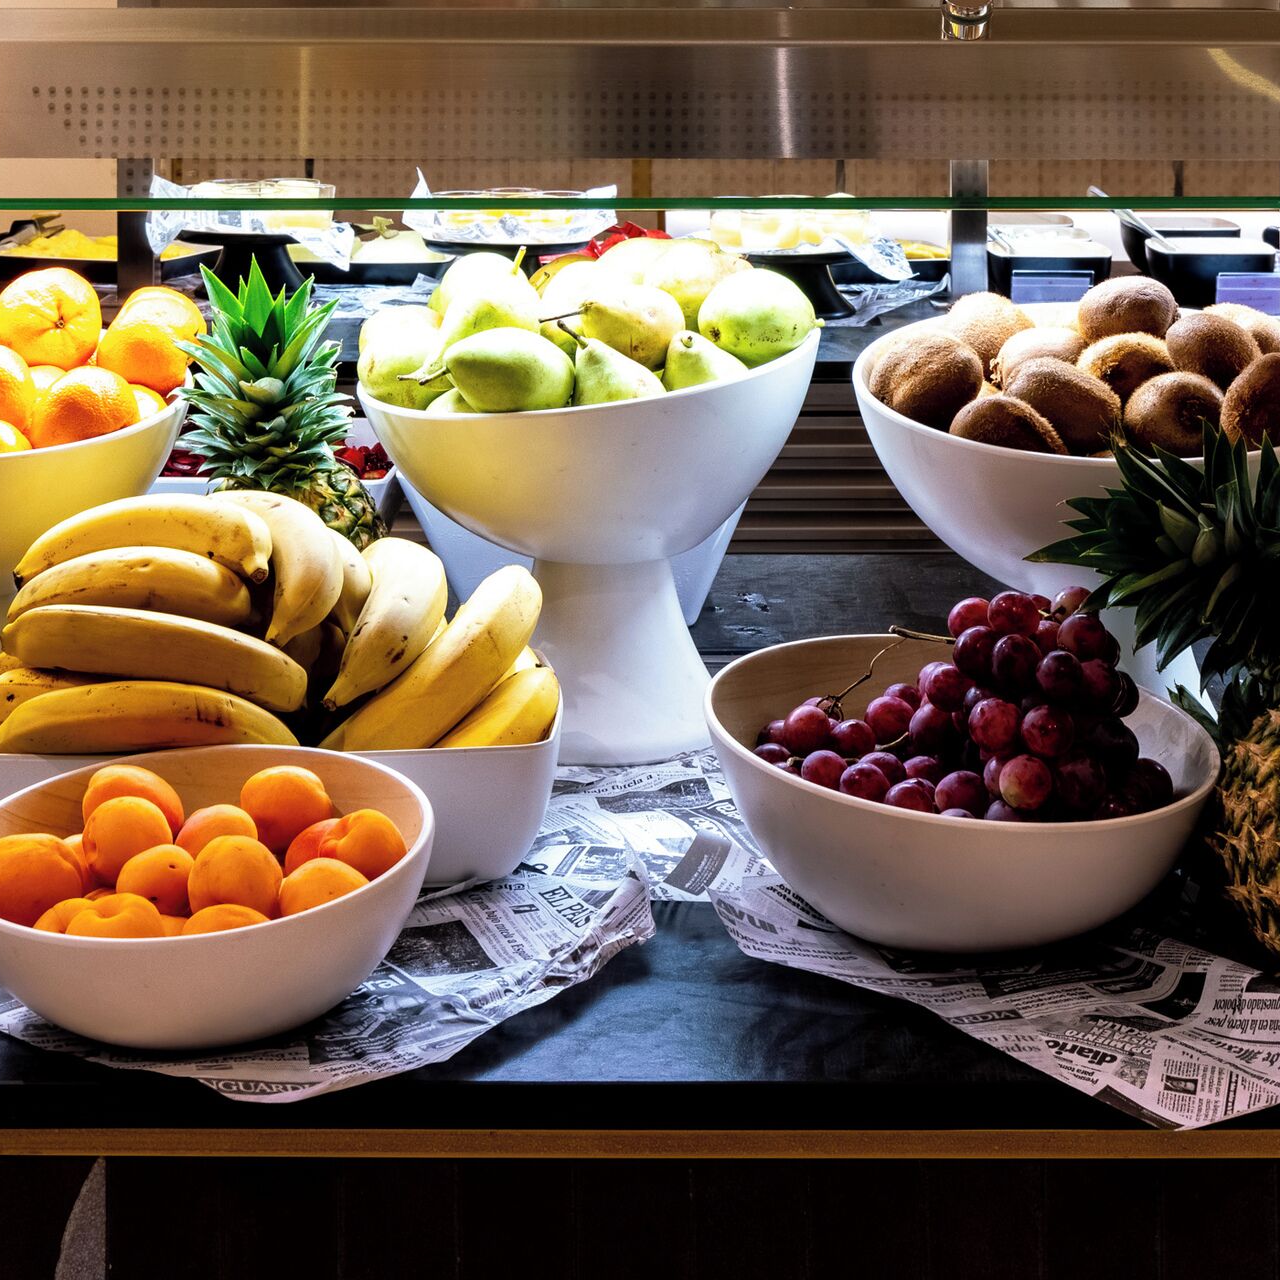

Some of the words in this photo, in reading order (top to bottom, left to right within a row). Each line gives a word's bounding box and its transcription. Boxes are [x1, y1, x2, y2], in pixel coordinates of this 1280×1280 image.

[538, 885, 569, 910] EL
[1258, 1019, 1269, 1030] en
[1044, 1038, 1118, 1066] diario
